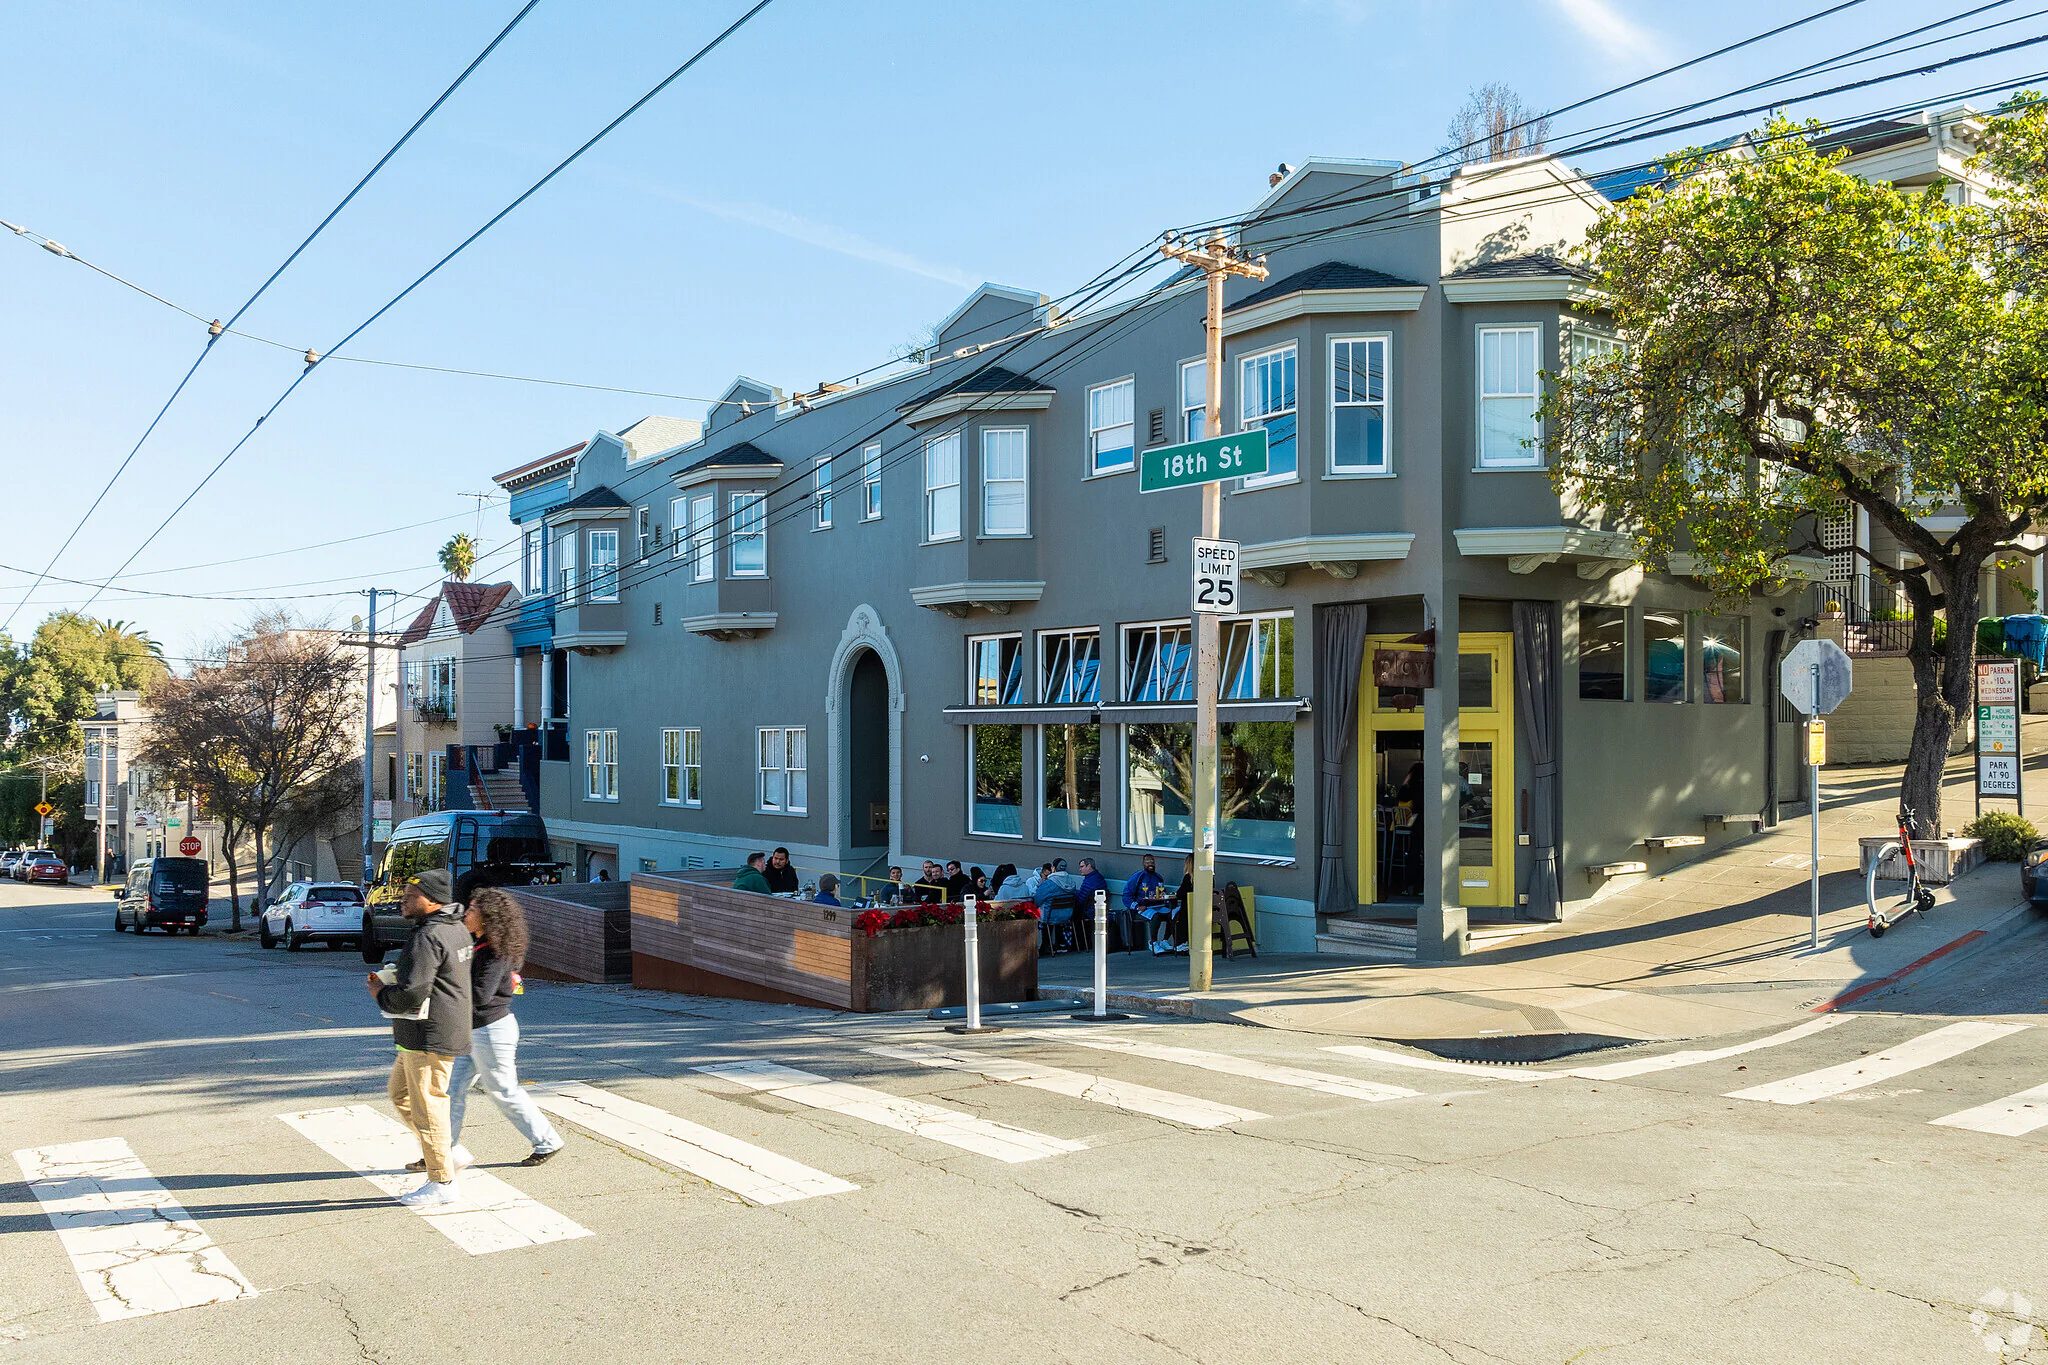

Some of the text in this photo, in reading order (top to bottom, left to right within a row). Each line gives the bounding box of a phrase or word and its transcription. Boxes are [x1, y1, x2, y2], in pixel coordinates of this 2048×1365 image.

[1163, 445, 1242, 478] 18th St
[1197, 547, 1235, 560] SPEED
[1200, 562, 1232, 575] LIMIT
[1197, 578, 1234, 606] 25
[1978, 665, 1989, 675] NO
[1981, 708, 1989, 718] 2
[1989, 761, 2008, 769] PARK
[1988, 771, 2009, 779] AT 90
[1983, 780, 2016, 789] DEGREES
[180, 843, 201, 851] STOP
